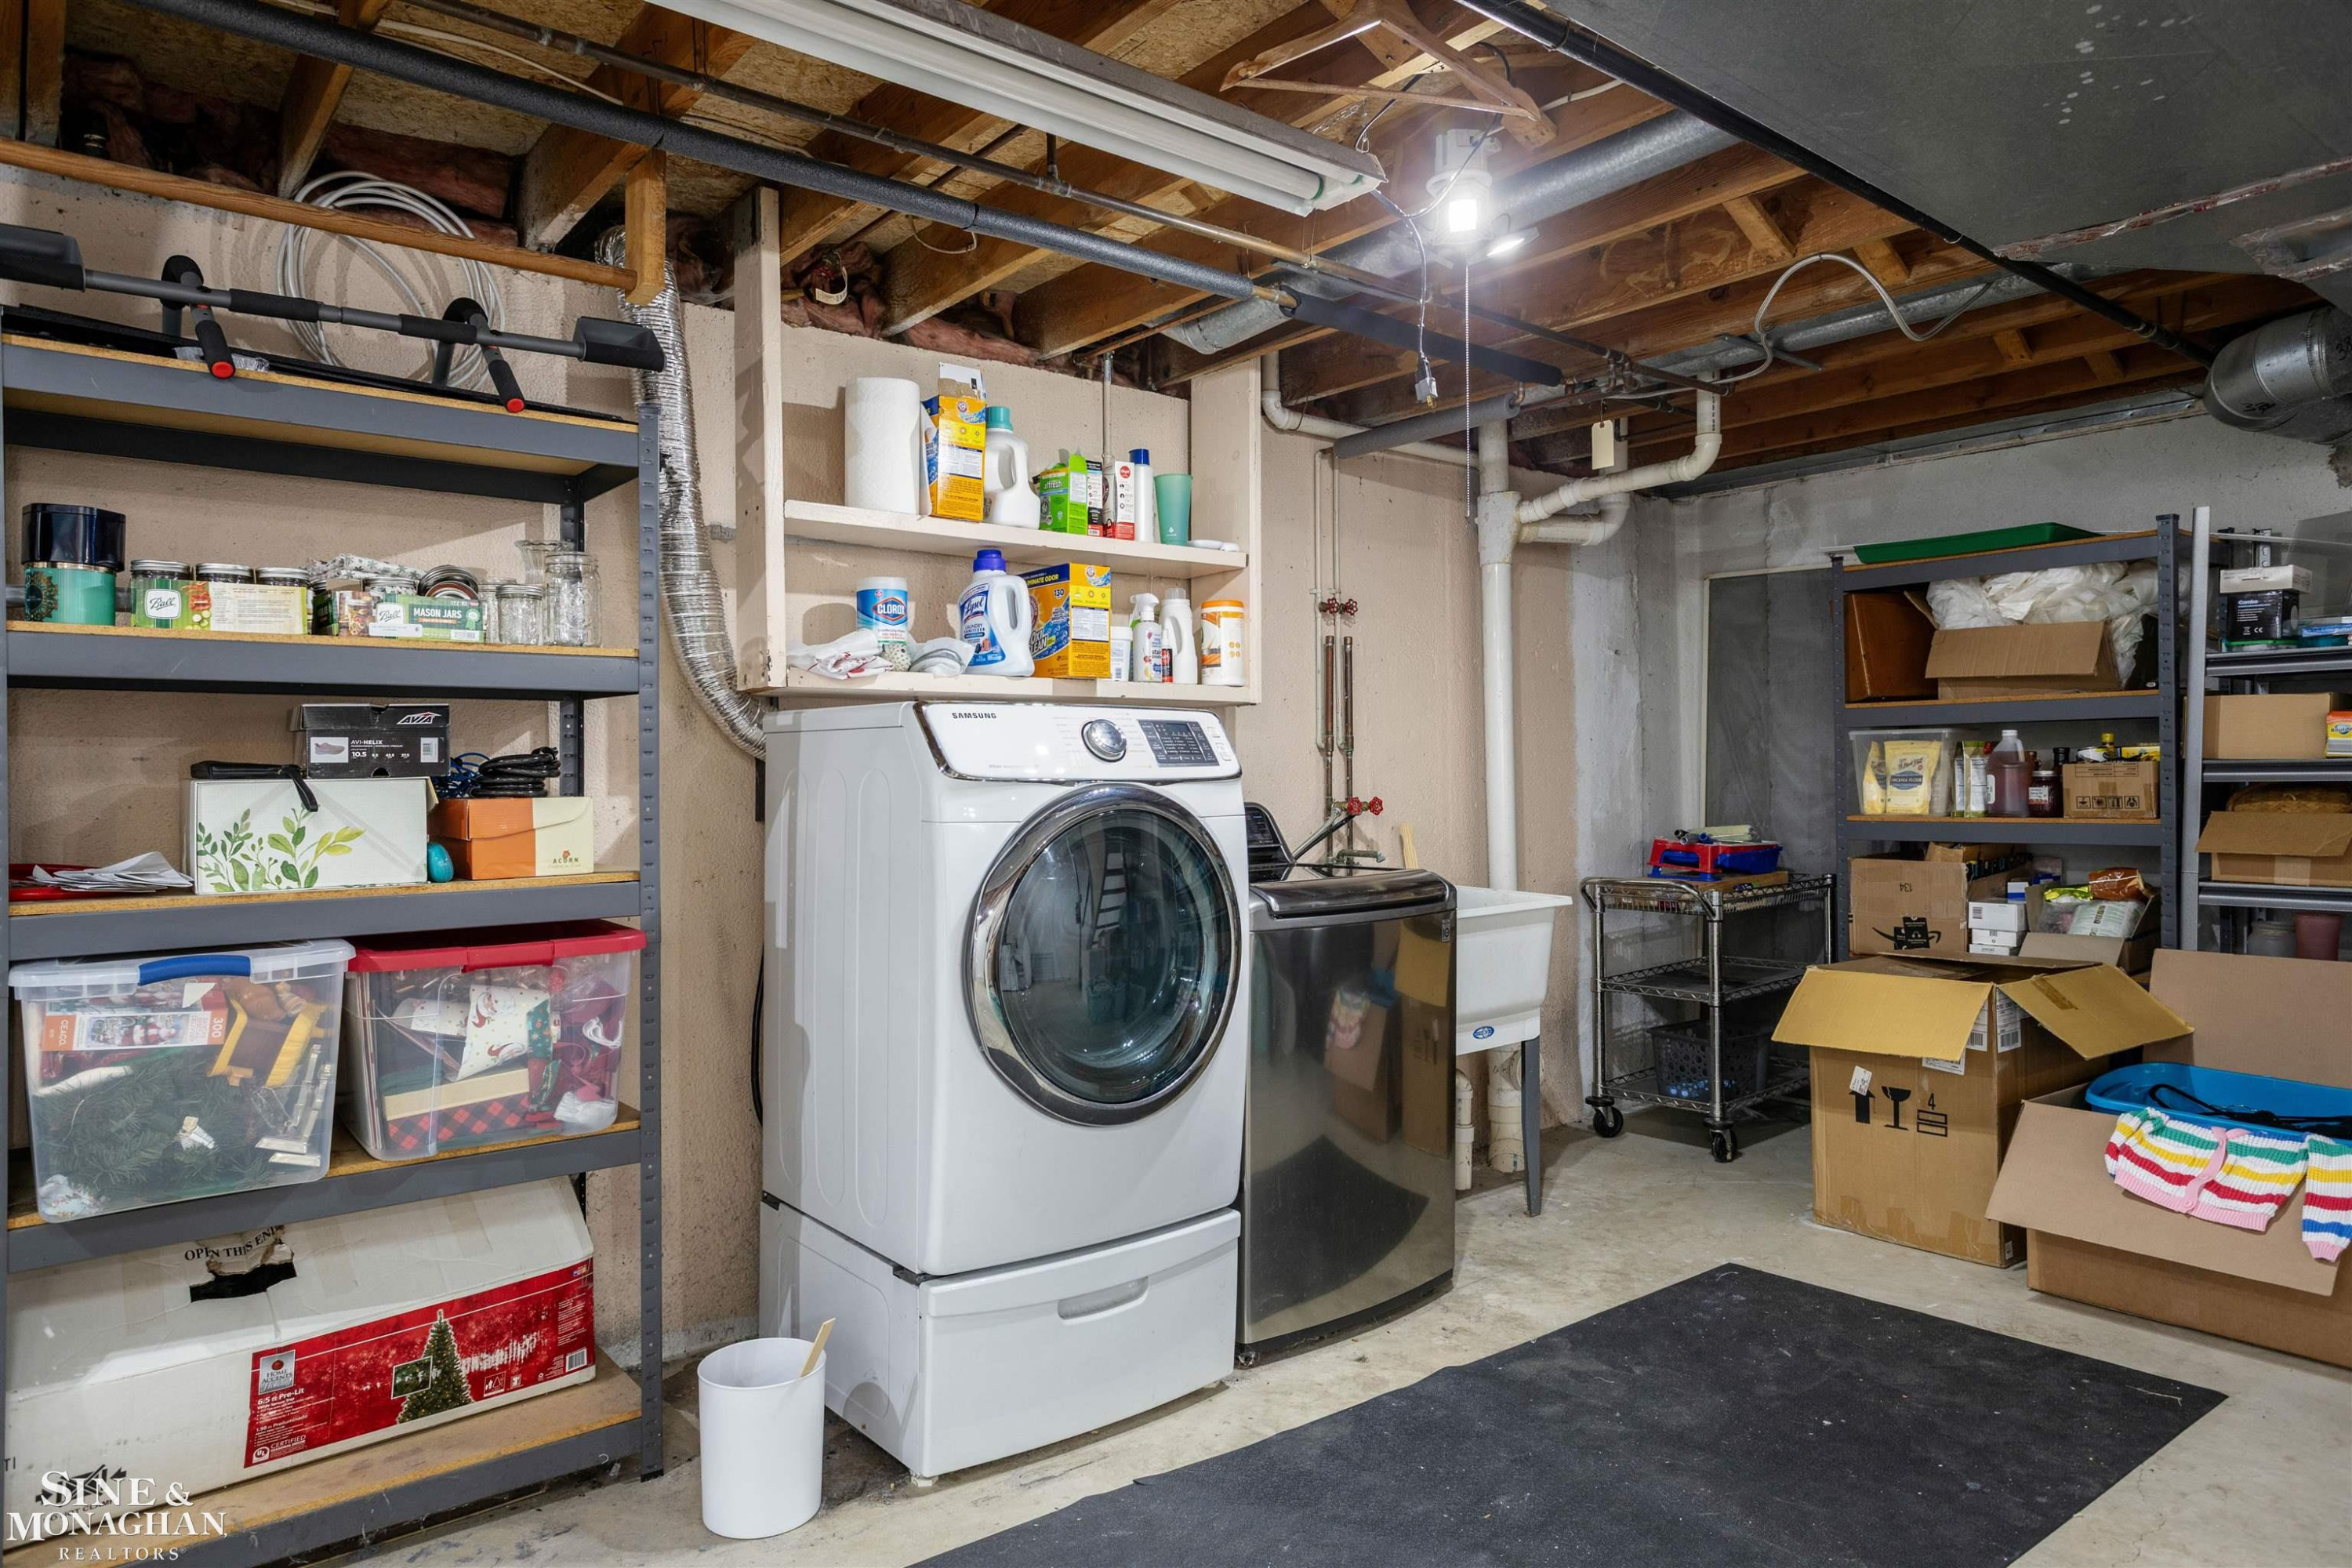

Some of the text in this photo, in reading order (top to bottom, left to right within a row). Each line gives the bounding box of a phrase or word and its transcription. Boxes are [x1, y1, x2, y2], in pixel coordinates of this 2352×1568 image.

[1044, 574, 1059, 583] ODOR
[1054, 588, 1065, 597] 130
[149, 597, 176, 611] Ball
[877, 604, 906, 615] CLOROX
[965, 596, 985, 615] Lysol
[379, 610, 402, 622] Ball
[413, 608, 441, 618] MASON
[442, 611, 463, 619] JARS
[1900, 883, 1913, 892] 134
[212, 1017, 224, 1038] 300
[1928, 1093, 1936, 1110] 4
[223, 1241, 252, 1257] THIS
[262, 1373, 293, 1384] ACCENTS
[267, 1369, 288, 1378] HOME
[278, 1388, 305, 1400] Pre-Lit
[270, 1434, 307, 1449] CERTIFIED
